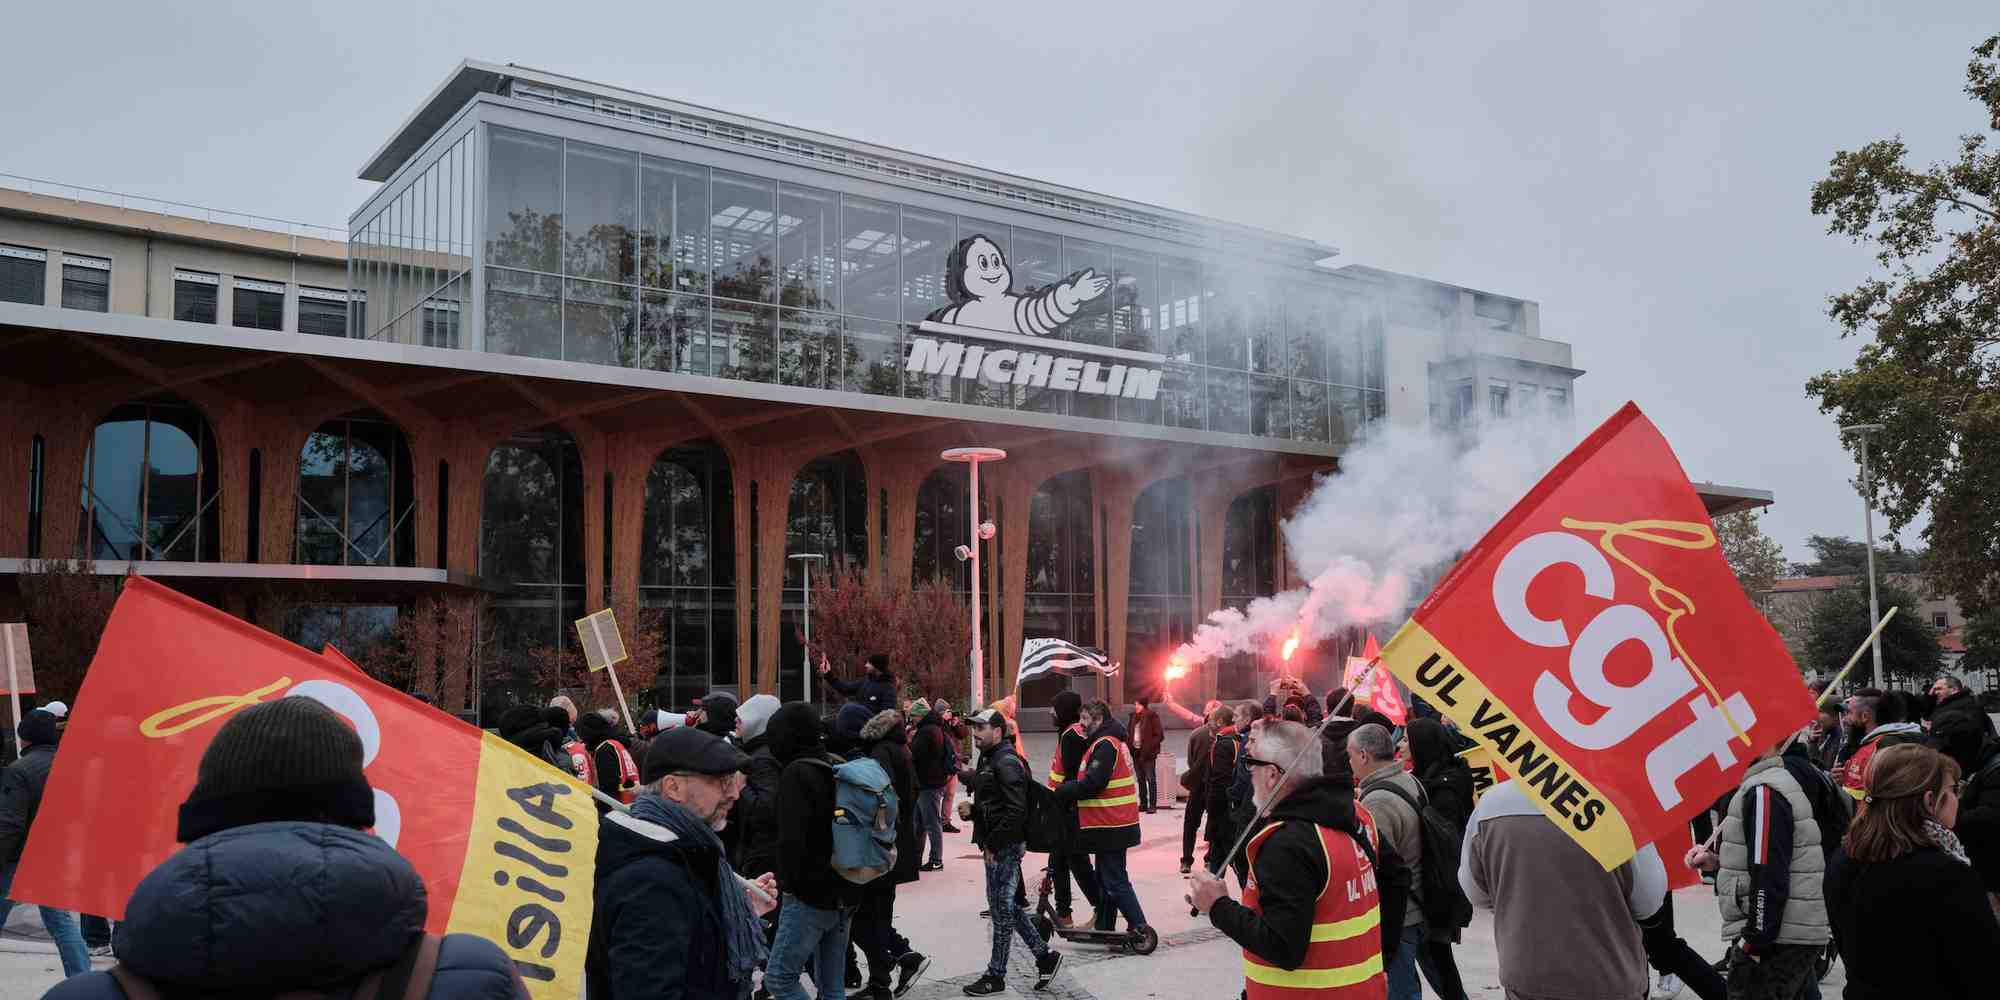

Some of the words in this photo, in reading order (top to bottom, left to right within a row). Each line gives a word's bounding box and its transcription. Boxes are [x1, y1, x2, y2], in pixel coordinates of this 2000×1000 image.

[905, 338, 1163, 400] MICHELIN
[1415, 652, 1465, 708] UL
[1470, 698, 1606, 832] VANNES
[1492, 531, 1757, 812] cgt
